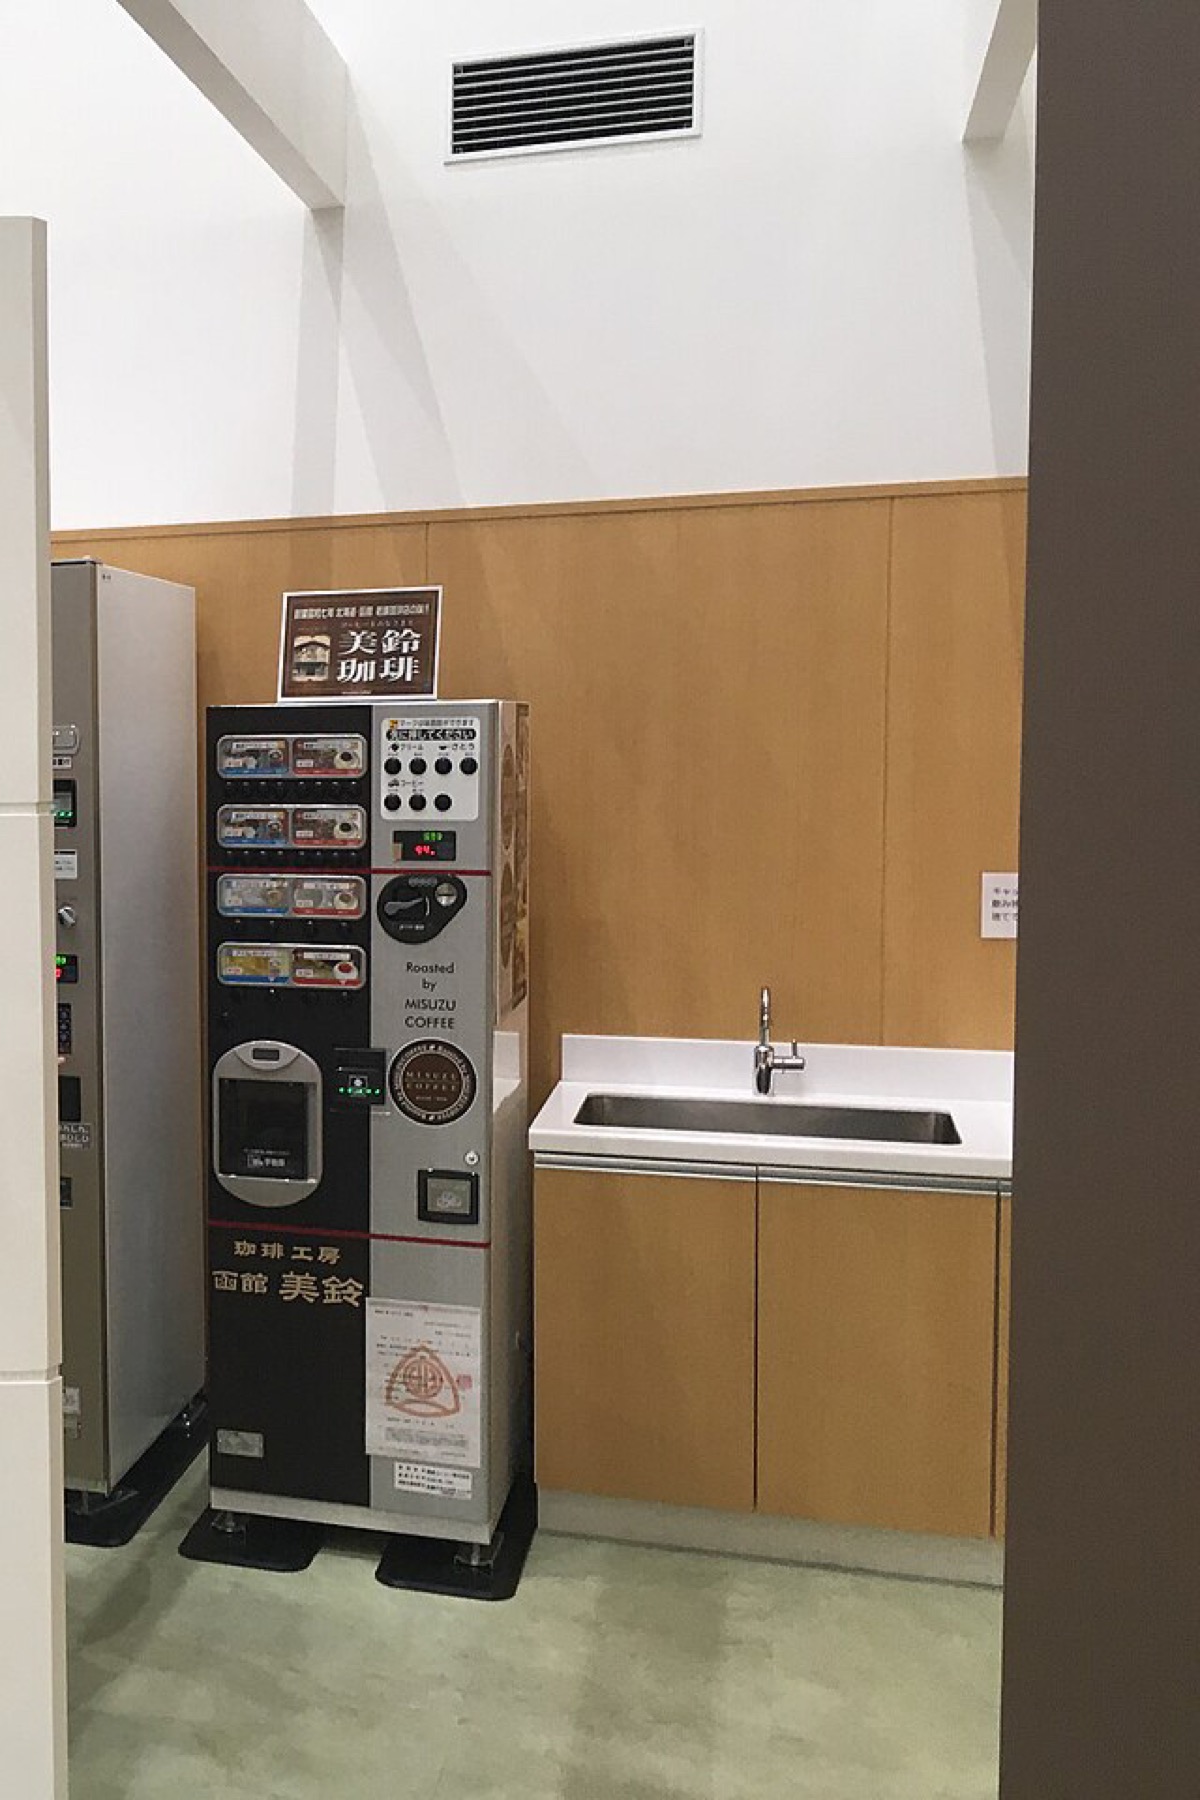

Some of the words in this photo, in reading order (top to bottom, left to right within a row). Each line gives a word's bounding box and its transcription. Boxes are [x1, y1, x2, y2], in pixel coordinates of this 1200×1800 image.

[338, 628, 422, 655] 美鈴
[336, 656, 420, 683] 珈琲
[406, 962, 455, 974] Roasted
[421, 978, 437, 992] by
[404, 998, 457, 1011] MISUZU
[404, 1016, 455, 1029] COFFEE
[233, 1240, 342, 1265] 珈琲工房
[211, 1270, 269, 1294] 函館
[278, 1270, 364, 1308] 美鈴
